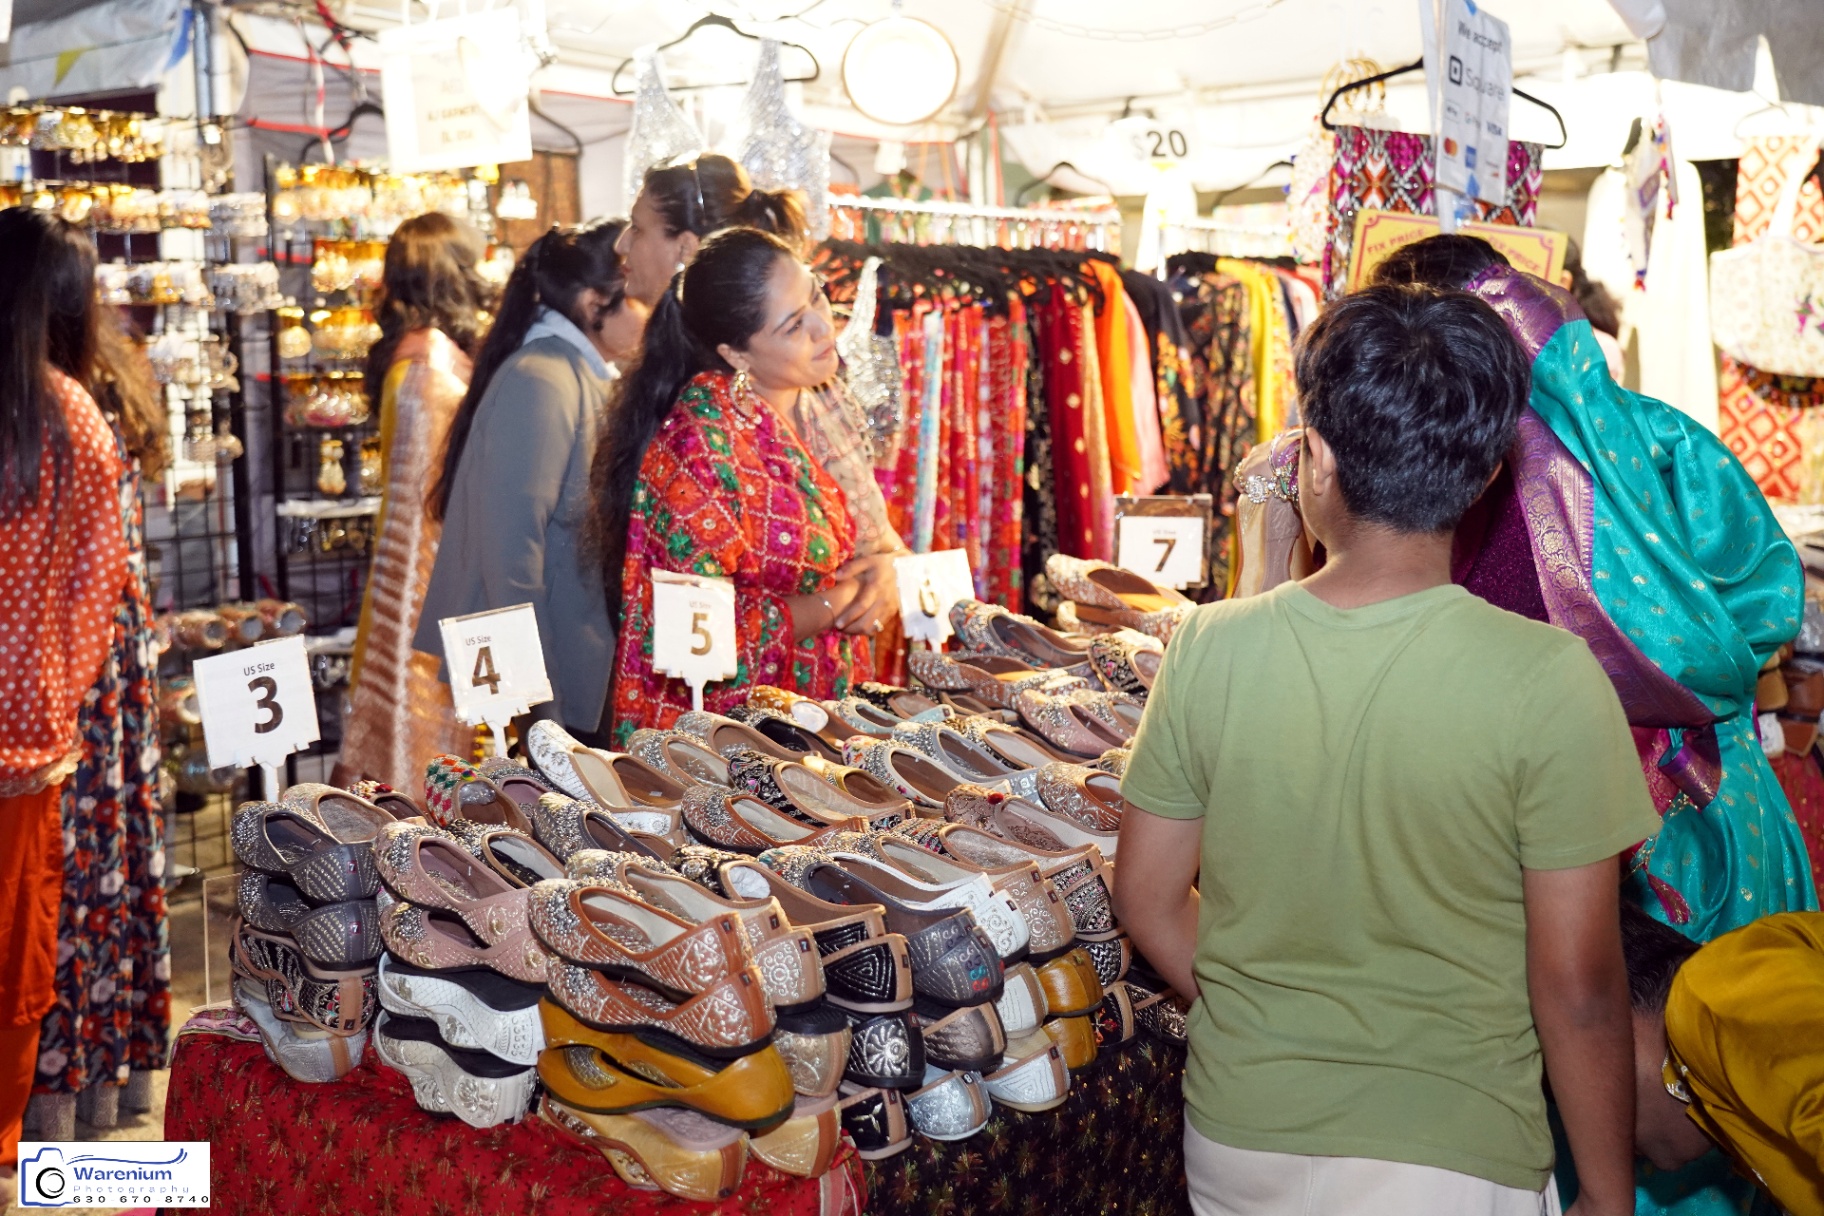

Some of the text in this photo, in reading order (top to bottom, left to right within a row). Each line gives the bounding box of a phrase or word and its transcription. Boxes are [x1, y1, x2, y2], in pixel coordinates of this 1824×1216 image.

[1458, 20, 1503, 54] We accept
[1466, 67, 1504, 102] Square
[1367, 228, 1425, 254] FIX PRICE
[1508, 247, 1541, 272] PRICE
[1153, 538, 1177, 572] 7
[465, 635, 492, 646] US Size
[690, 612, 713, 656] 5
[243, 662, 275, 676] US Size
[472, 646, 501, 695] 4
[247, 676, 284, 734] 3
